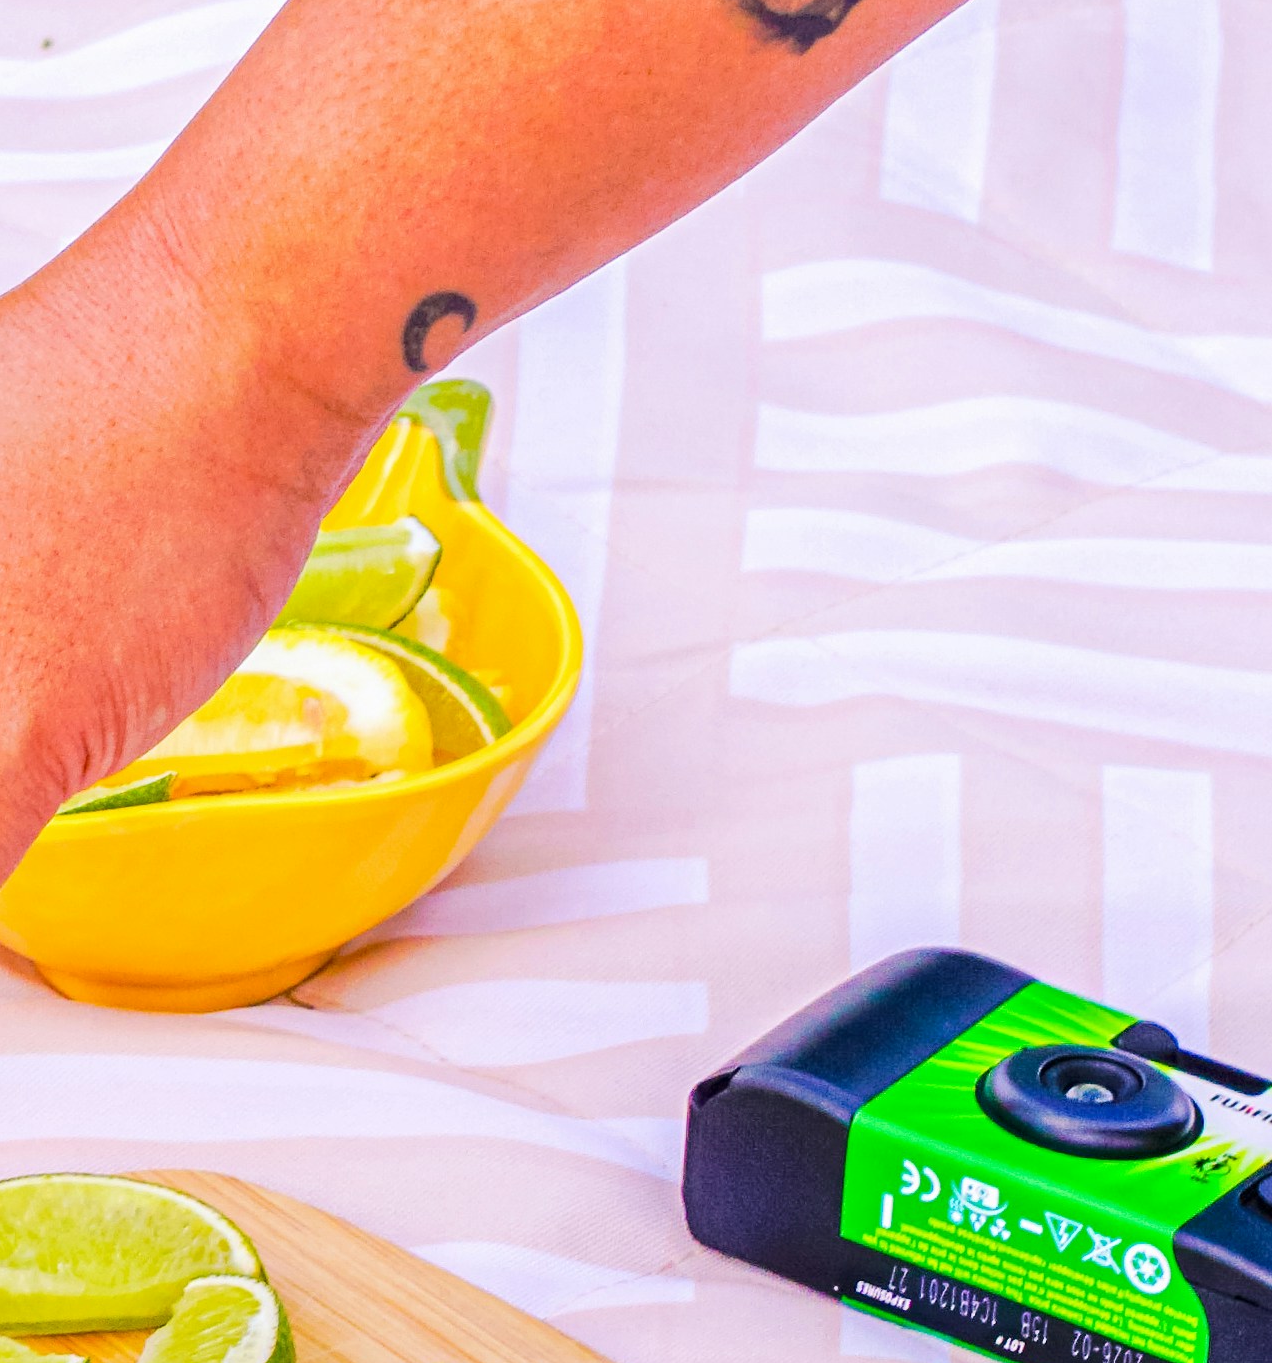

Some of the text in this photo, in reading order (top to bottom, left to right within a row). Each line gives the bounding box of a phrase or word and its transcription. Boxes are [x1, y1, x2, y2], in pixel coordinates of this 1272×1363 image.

[888, 1265, 909, 1294] 27
[855, 1280, 912, 1311] EXPOSURES
[1003, 1337, 1026, 1354] LOT
